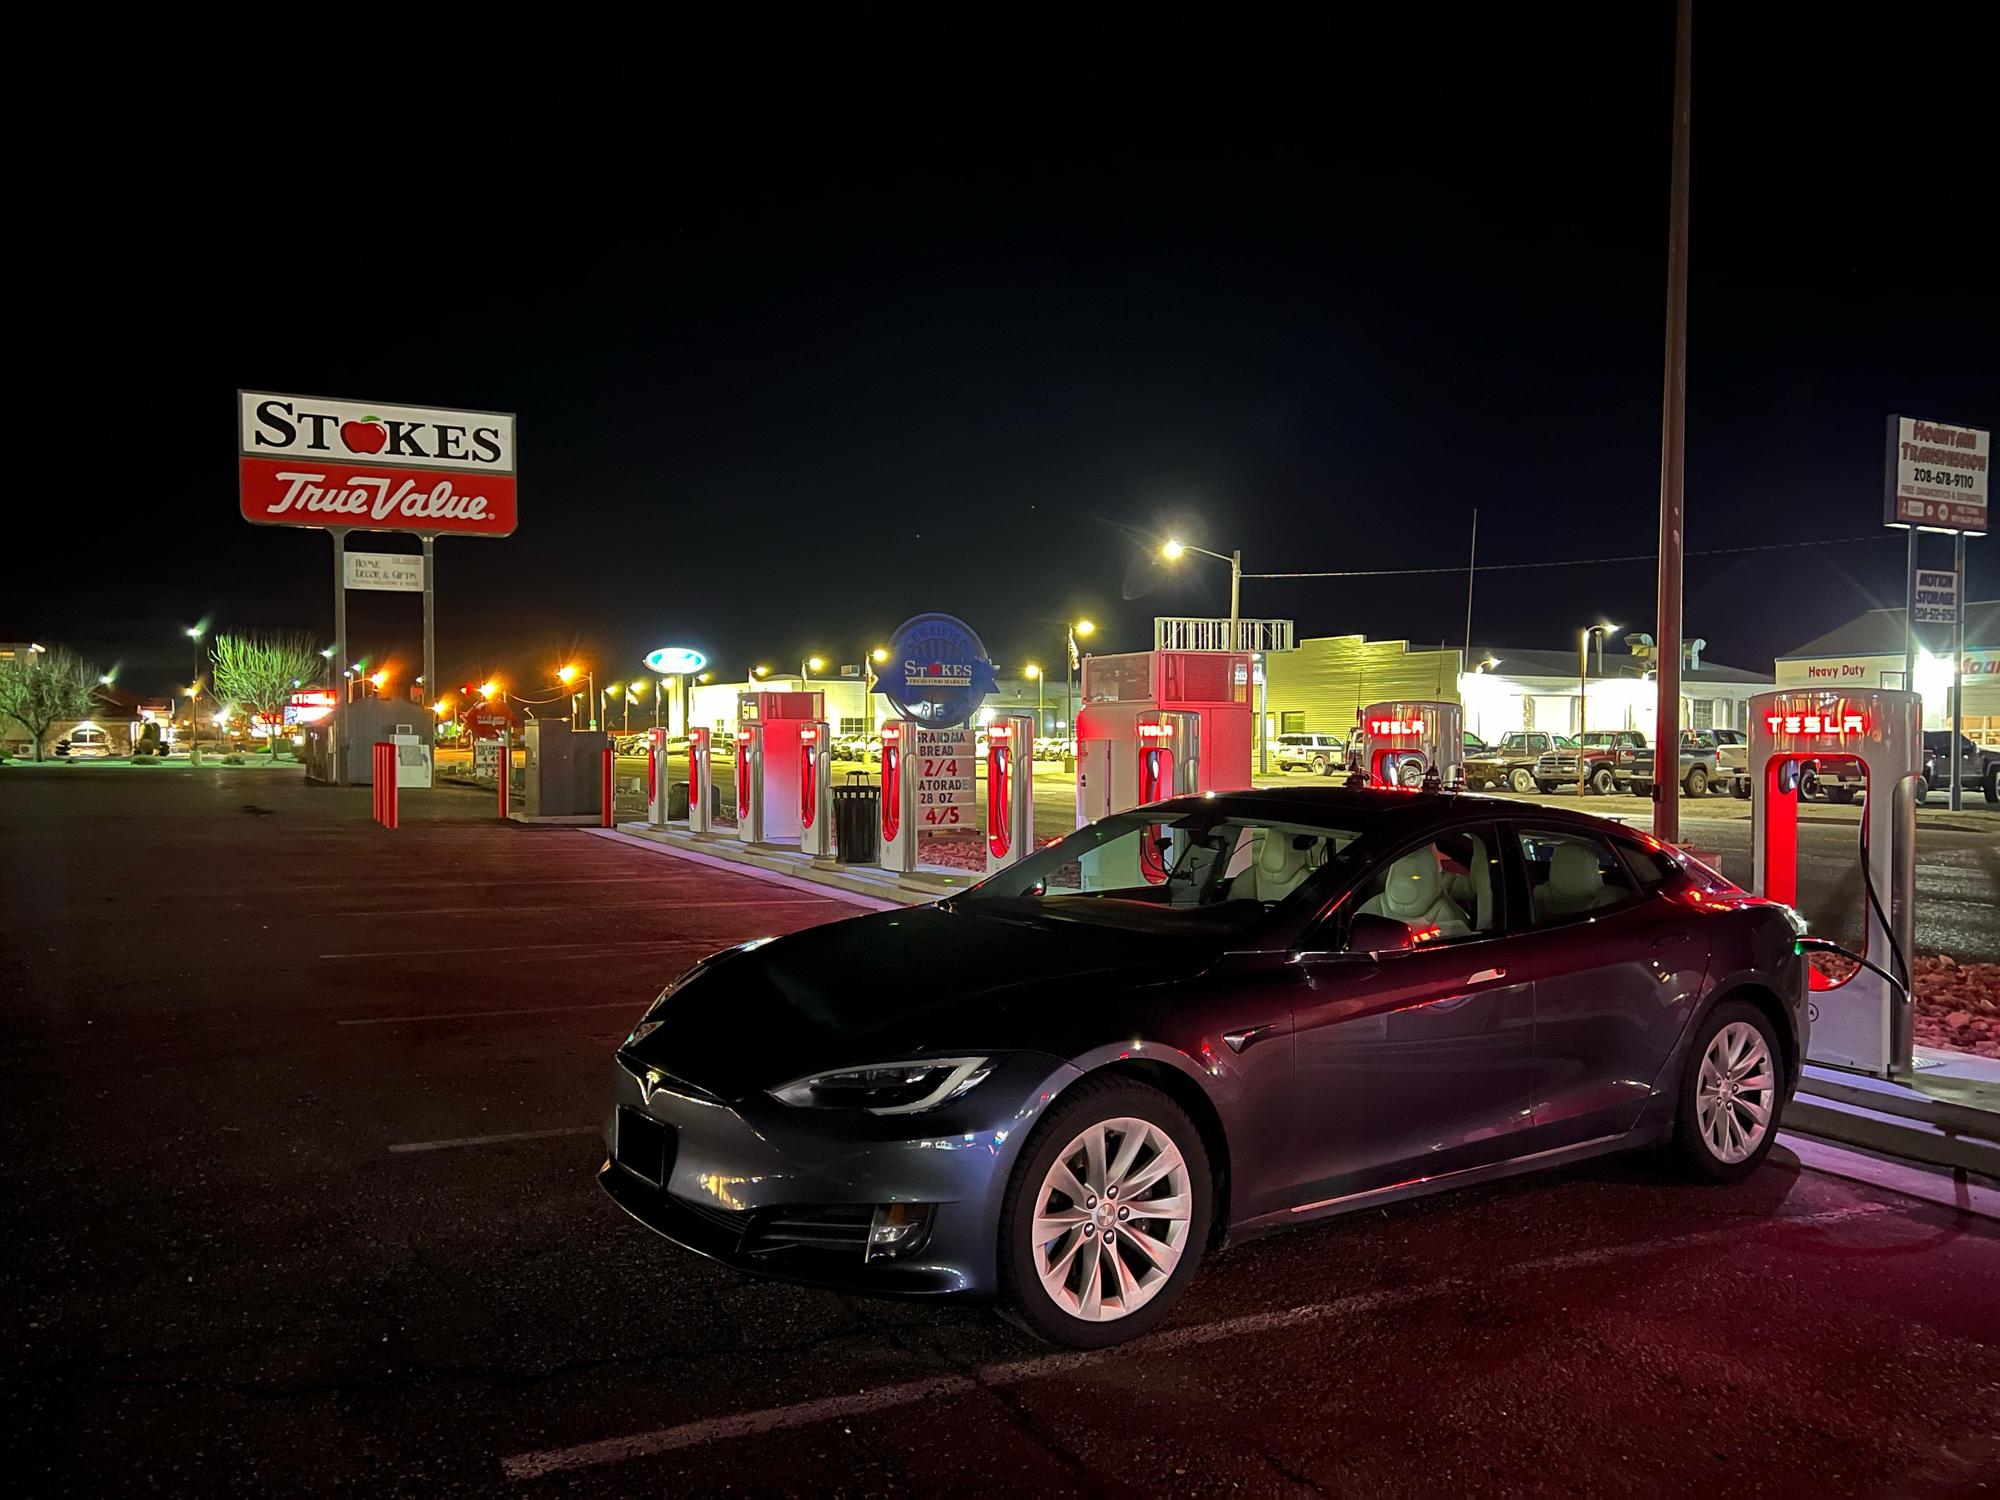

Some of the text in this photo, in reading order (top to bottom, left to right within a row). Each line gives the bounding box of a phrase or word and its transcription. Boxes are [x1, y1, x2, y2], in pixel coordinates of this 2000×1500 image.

[1914, 468, 1974, 489] 208-678-9110
[1808, 664, 1865, 679] Heavy Duty
[1371, 720, 1425, 734] TESLA
[1767, 715, 1862, 733] TESLA
[920, 745, 954, 757] BREAD
[924, 759, 958, 777] 2/4
[920, 793, 954, 804] 28 OZ
[926, 806, 960, 825] 4/5
